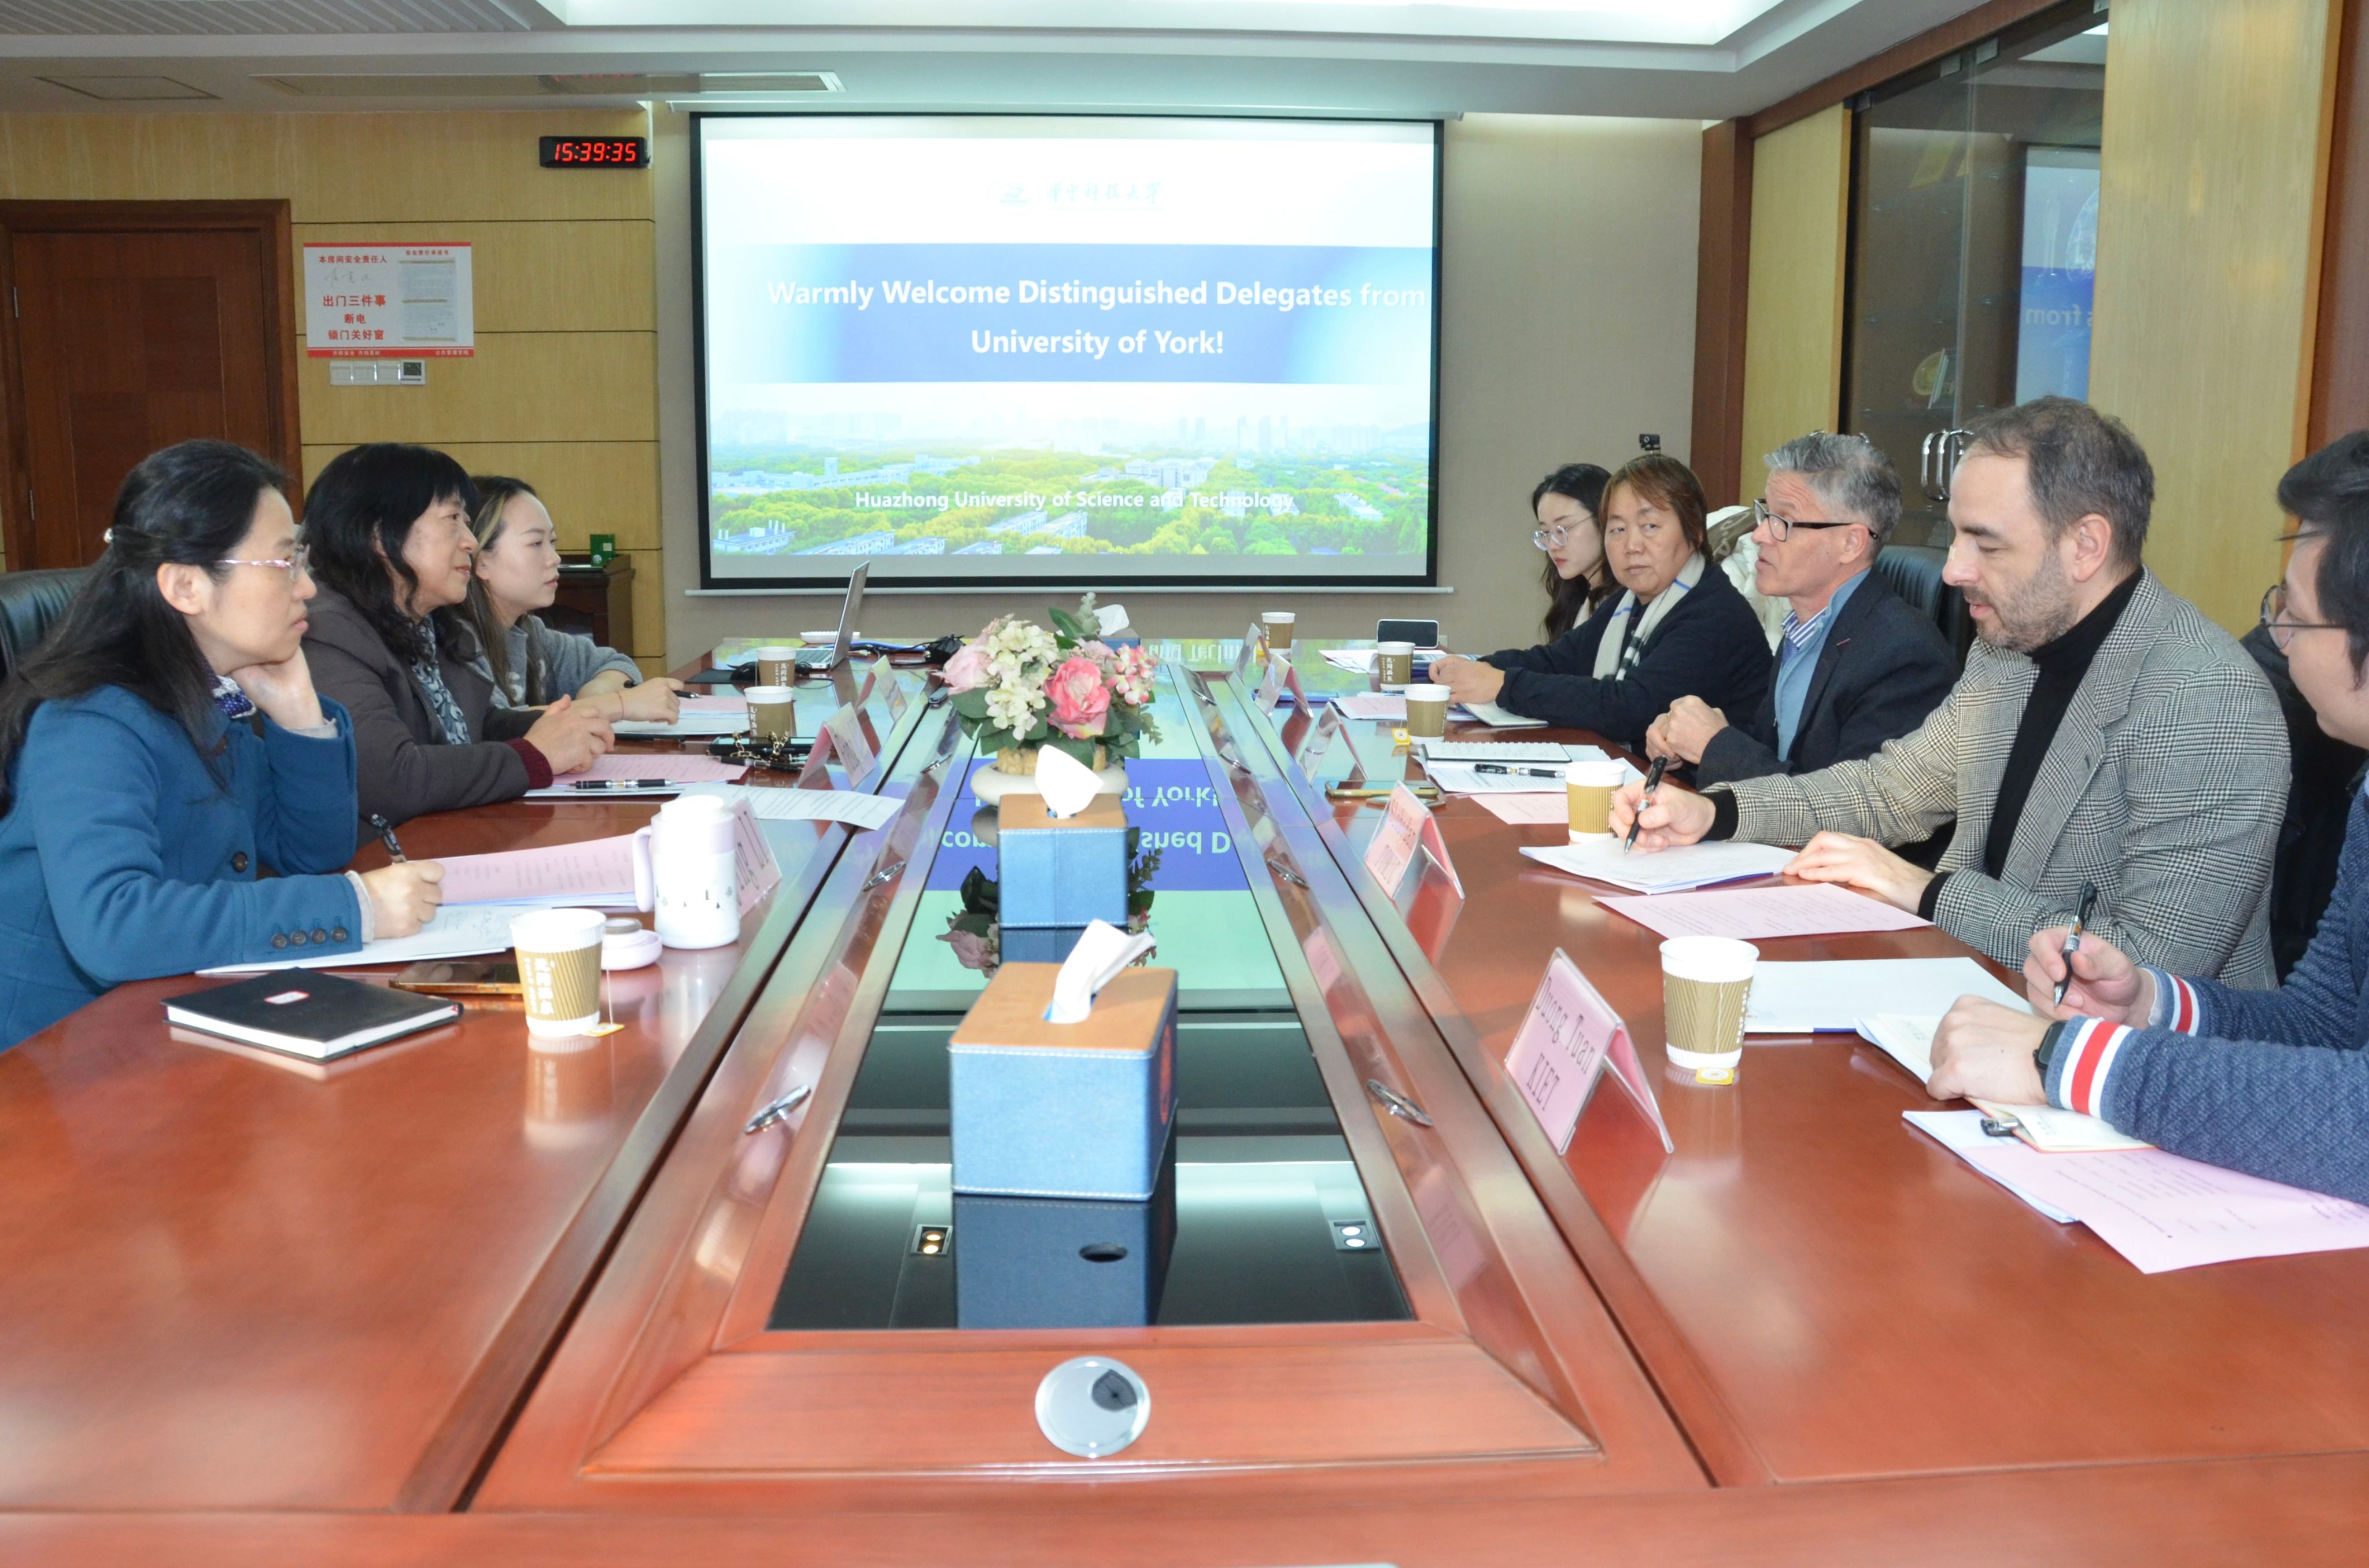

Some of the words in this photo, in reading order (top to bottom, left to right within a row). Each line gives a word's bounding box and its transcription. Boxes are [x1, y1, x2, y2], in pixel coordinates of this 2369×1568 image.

[555, 142, 637, 161] 15:39:35
[319, 255, 387, 263] 本房间安全责任人
[323, 294, 386, 307] 出门三件事
[767, 279, 874, 311] Warmly
[882, 279, 1010, 304] Welcome
[1019, 279, 1207, 311] Distinguished
[1216, 281, 1352, 312] Delegates
[1360, 282, 1426, 307] from
[344, 313, 366, 324] 断电
[328, 329, 384, 340] 锁门关好窗
[971, 329, 1109, 360] University
[1117, 329, 1147, 354] of
[1154, 330, 1224, 355] York!
[855, 491, 949, 511] Huazhong
[954, 491, 1046, 511] University
[1051, 490, 1072, 508] of
[1076, 490, 1143, 507] Science
[1149, 491, 1184, 508] and
[1190, 491, 1295, 512] Technology
[1536, 976, 1569, 1044] Duong
[1565, 1014, 1596, 1075] Tuan
[1526, 1053, 1560, 1112] KIET
